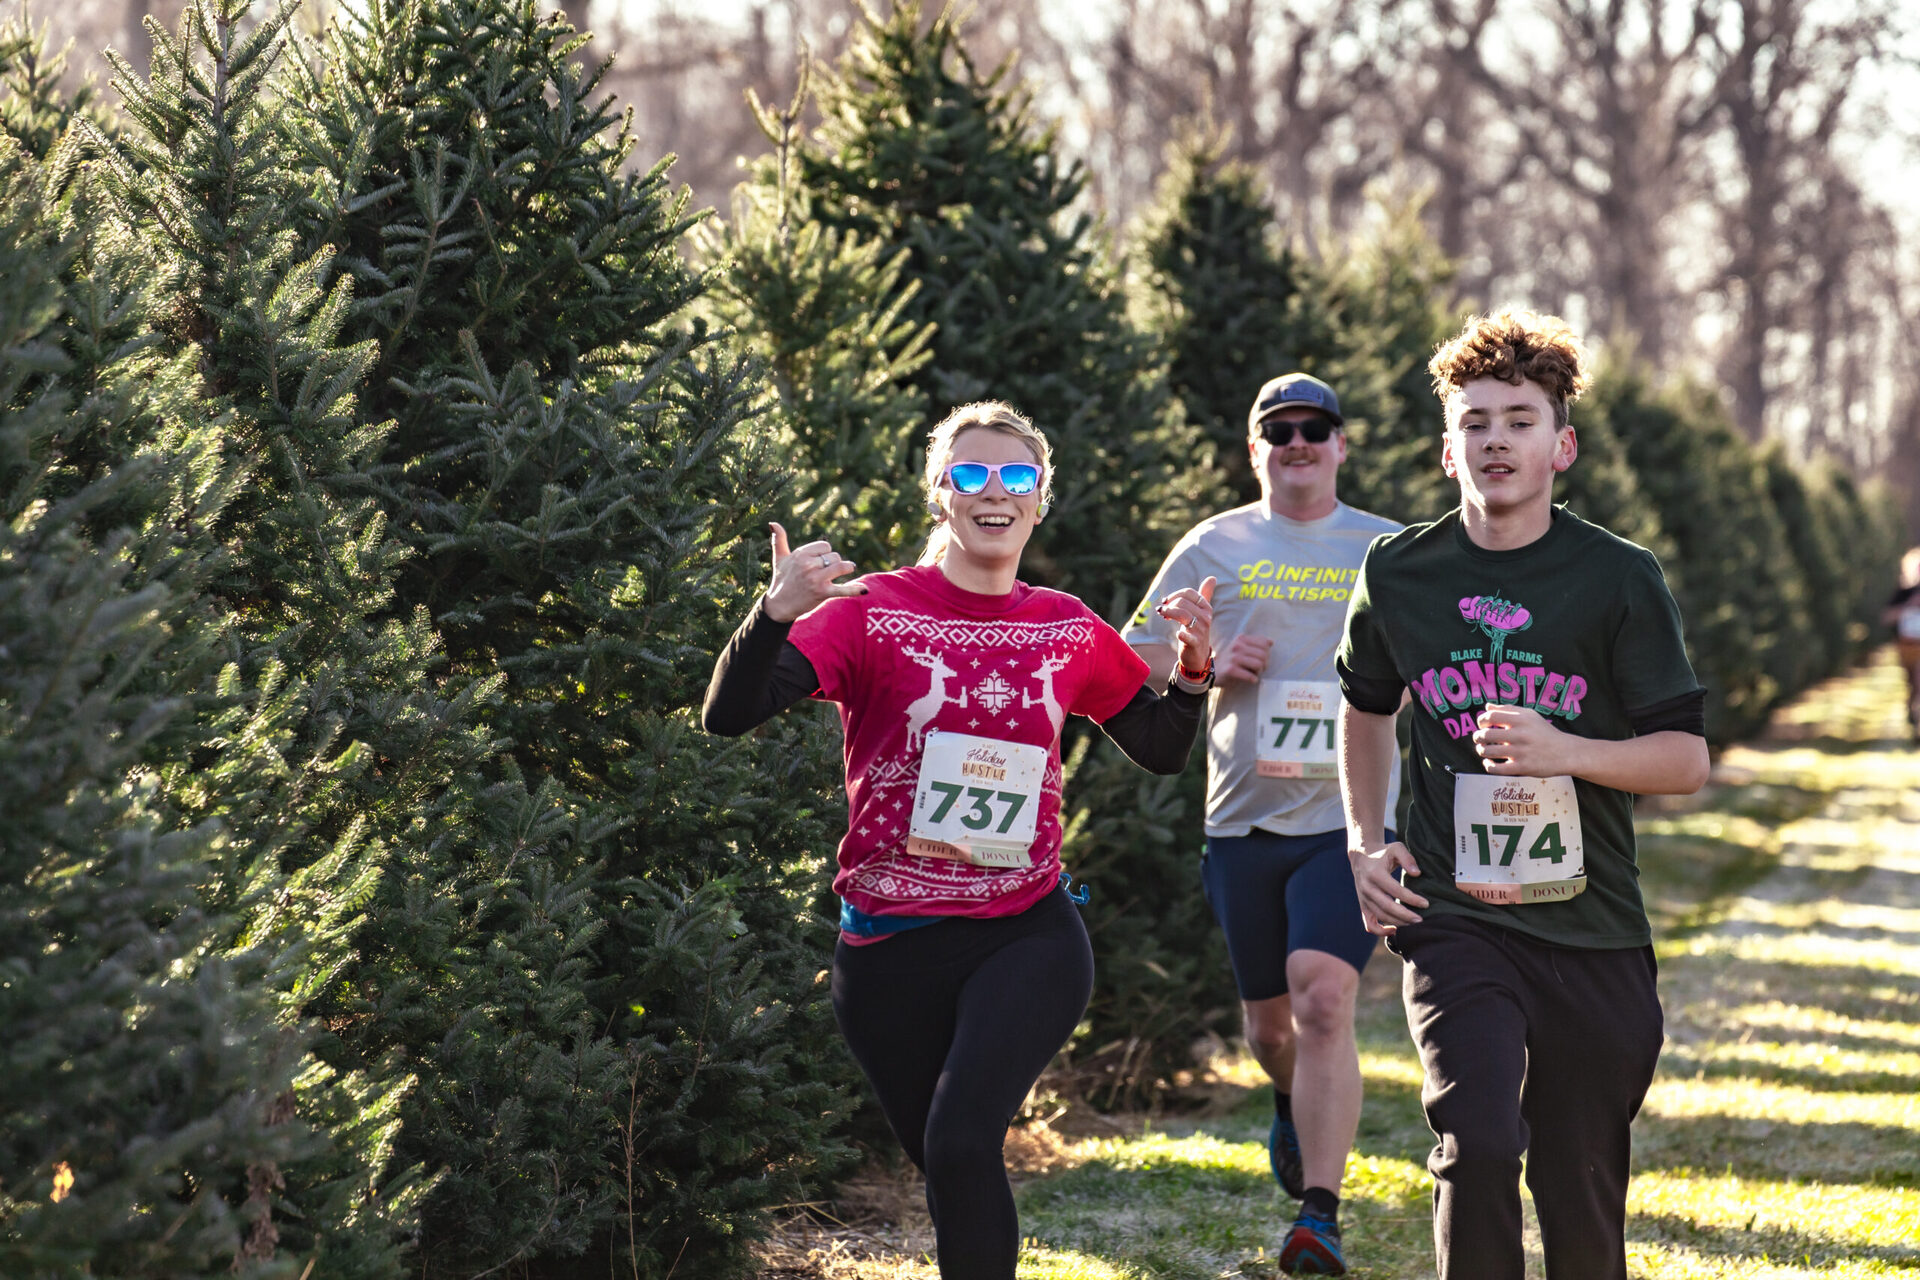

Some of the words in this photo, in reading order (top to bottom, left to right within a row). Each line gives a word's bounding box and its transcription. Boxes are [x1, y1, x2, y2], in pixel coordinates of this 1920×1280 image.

[1239, 582, 1354, 602] MULTISPO
[1450, 649, 1483, 662] BLAKE
[1506, 649, 1543, 665] FARMS
[1411, 660, 1588, 721] MONSTER
[1271, 717, 1335, 750] 771
[1443, 710, 1486, 740] DA
[966, 748, 1007, 767] Holiday
[962, 763, 1007, 781] HUSTLE
[1493, 787, 1536, 803] Holiday
[928, 781, 1028, 834] 737
[1491, 802, 1539, 816] HUSTLE
[1471, 822, 1567, 866] 174
[1468, 889, 1507, 900] CIDER
[1533, 885, 1578, 898] DONUT
